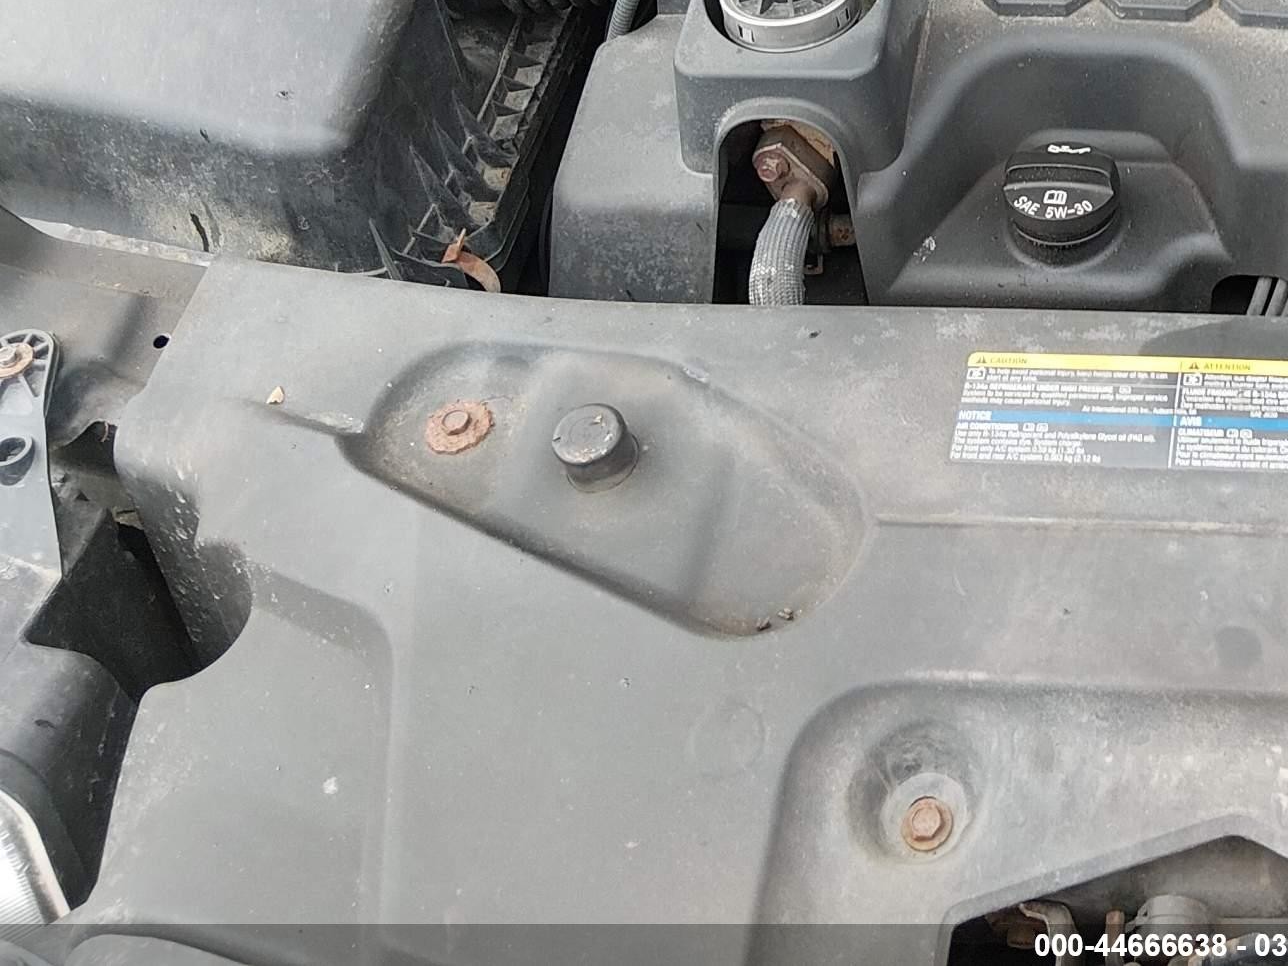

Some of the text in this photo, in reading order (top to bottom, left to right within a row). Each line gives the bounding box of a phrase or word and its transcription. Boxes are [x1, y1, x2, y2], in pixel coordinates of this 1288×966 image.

[1013, 195, 1094, 219] SAE 5W-30
[990, 357, 1028, 365] CAUTION
[1203, 362, 1251, 371] ATTENTION
[958, 410, 992, 421] NOTICE
[1179, 415, 1202, 427] AVIS
